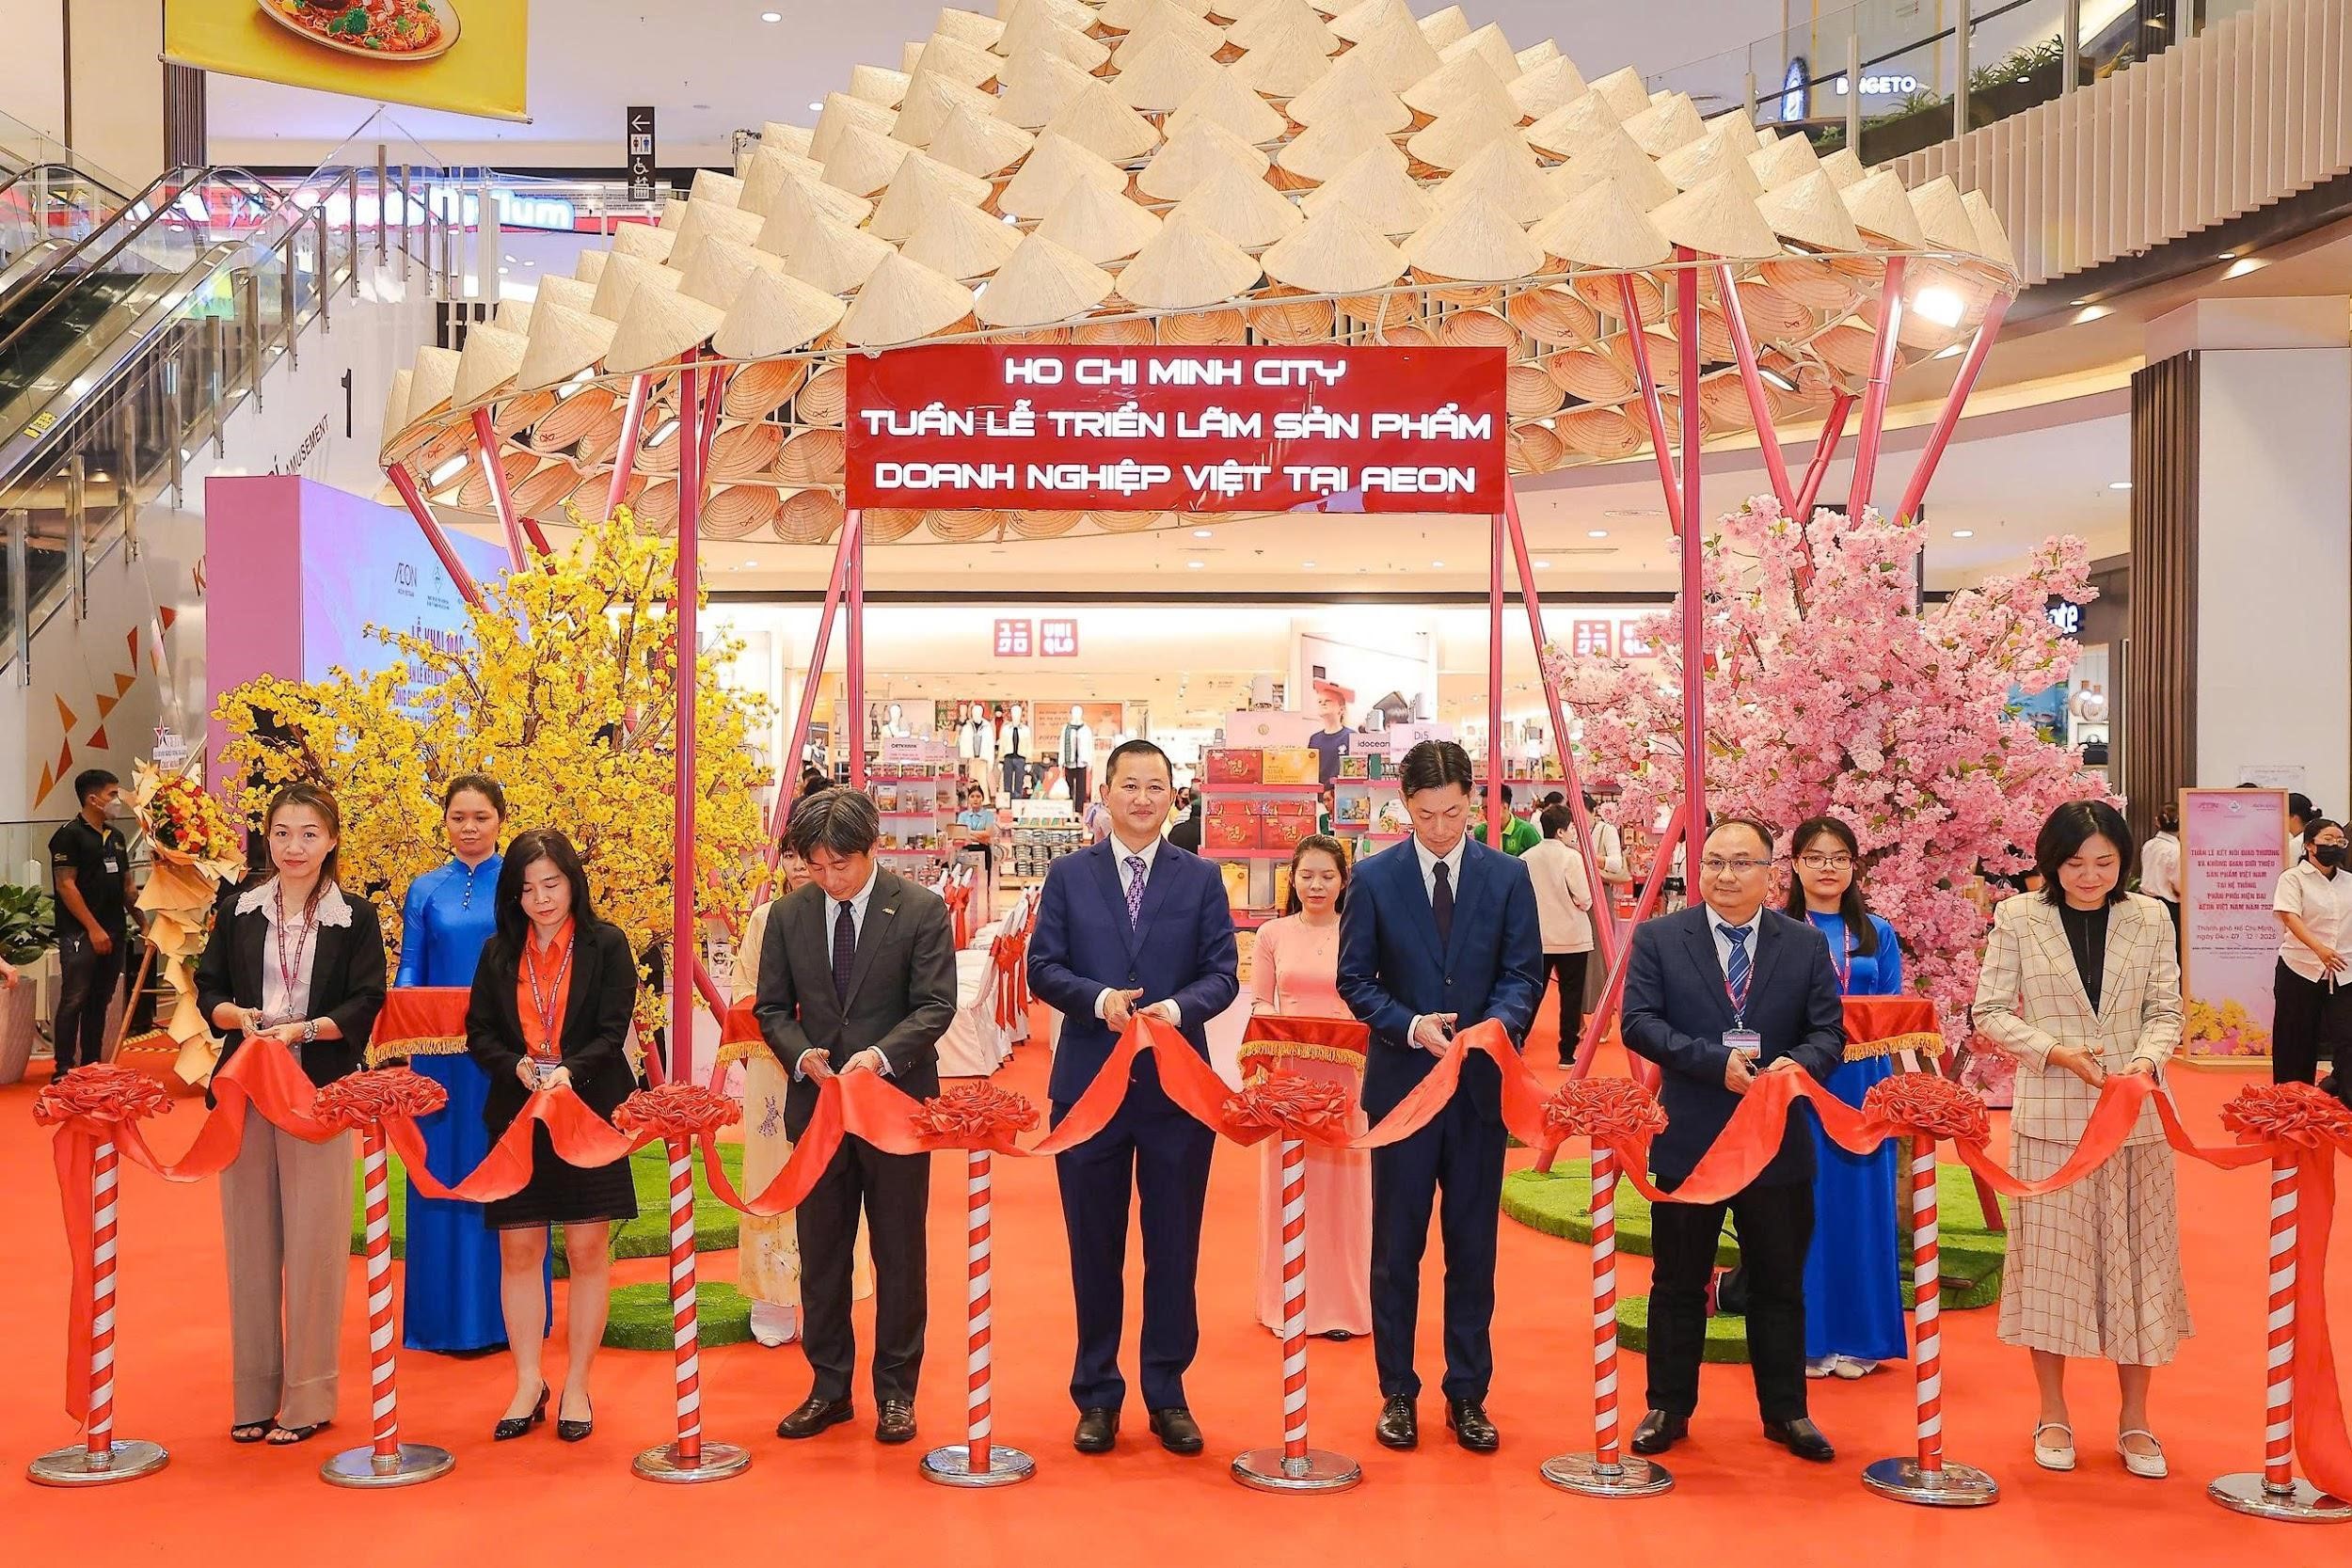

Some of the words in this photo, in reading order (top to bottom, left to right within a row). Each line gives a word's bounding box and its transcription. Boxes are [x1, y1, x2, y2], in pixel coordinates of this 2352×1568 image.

[1005, 357, 1063, 385] HO
[1075, 358, 1137, 385] CHI
[1149, 358, 1242, 386] MINH
[1253, 359, 1346, 386] CITY
[986, 399, 1036, 437] LỄ
[1047, 401, 1165, 438] TRIỂN
[1177, 406, 1262, 438] LÃM
[1273, 405, 1359, 439] SẢN
[1372, 403, 1491, 440] PHẨM
[876, 463, 1014, 489] DOANH
[1027, 458, 1171, 497] NGHIỆP
[1183, 459, 1272, 497] VIỆT
[1282, 466, 1348, 497] TẠI
[1360, 467, 1475, 493] AEON
